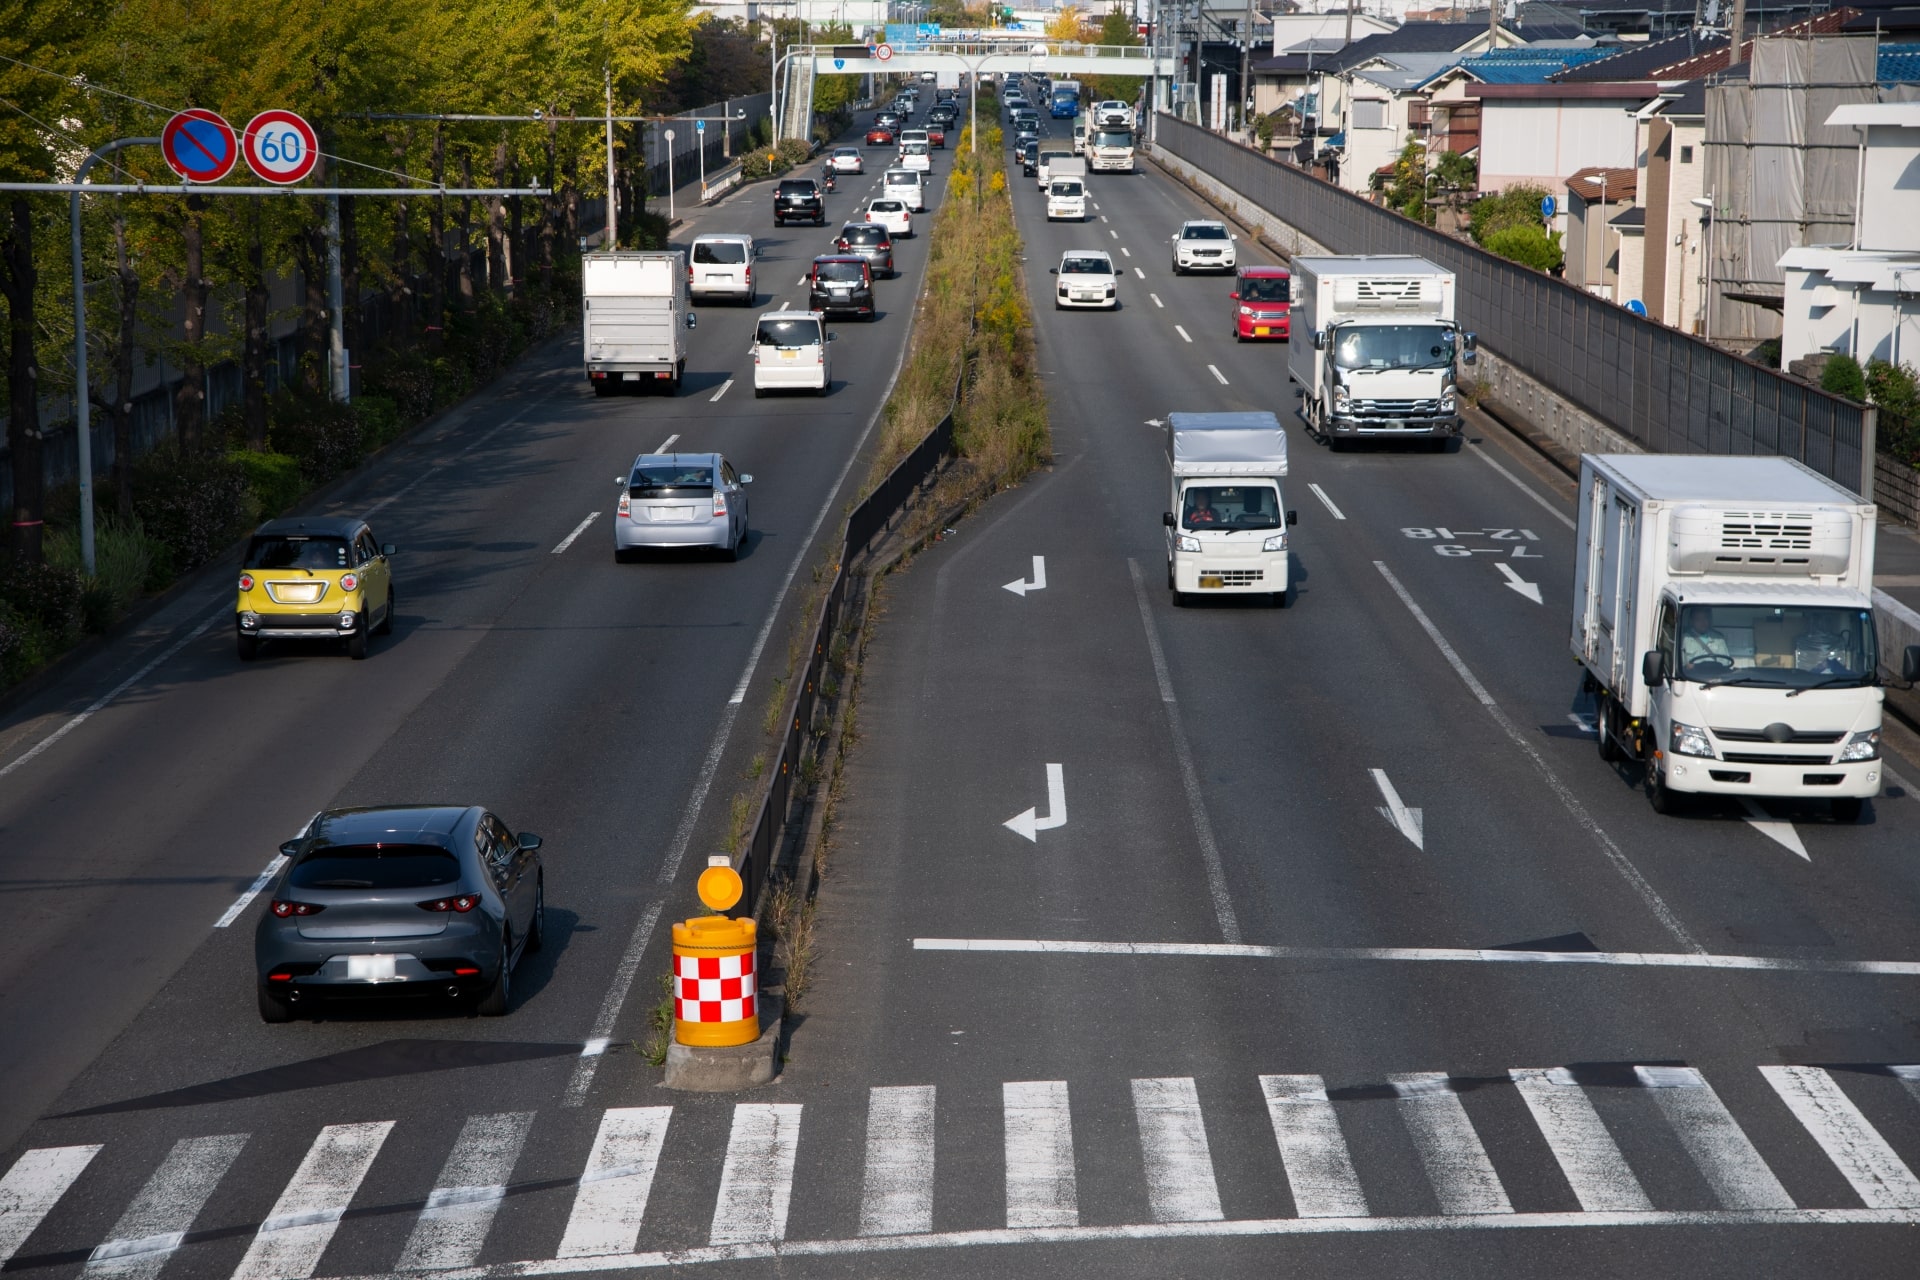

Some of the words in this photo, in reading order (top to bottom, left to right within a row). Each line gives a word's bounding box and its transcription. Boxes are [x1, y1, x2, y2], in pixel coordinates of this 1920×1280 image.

[261, 131, 301, 163] 60
[1400, 527, 1541, 541] 12-18
[1433, 544, 1544, 558] 7-9
